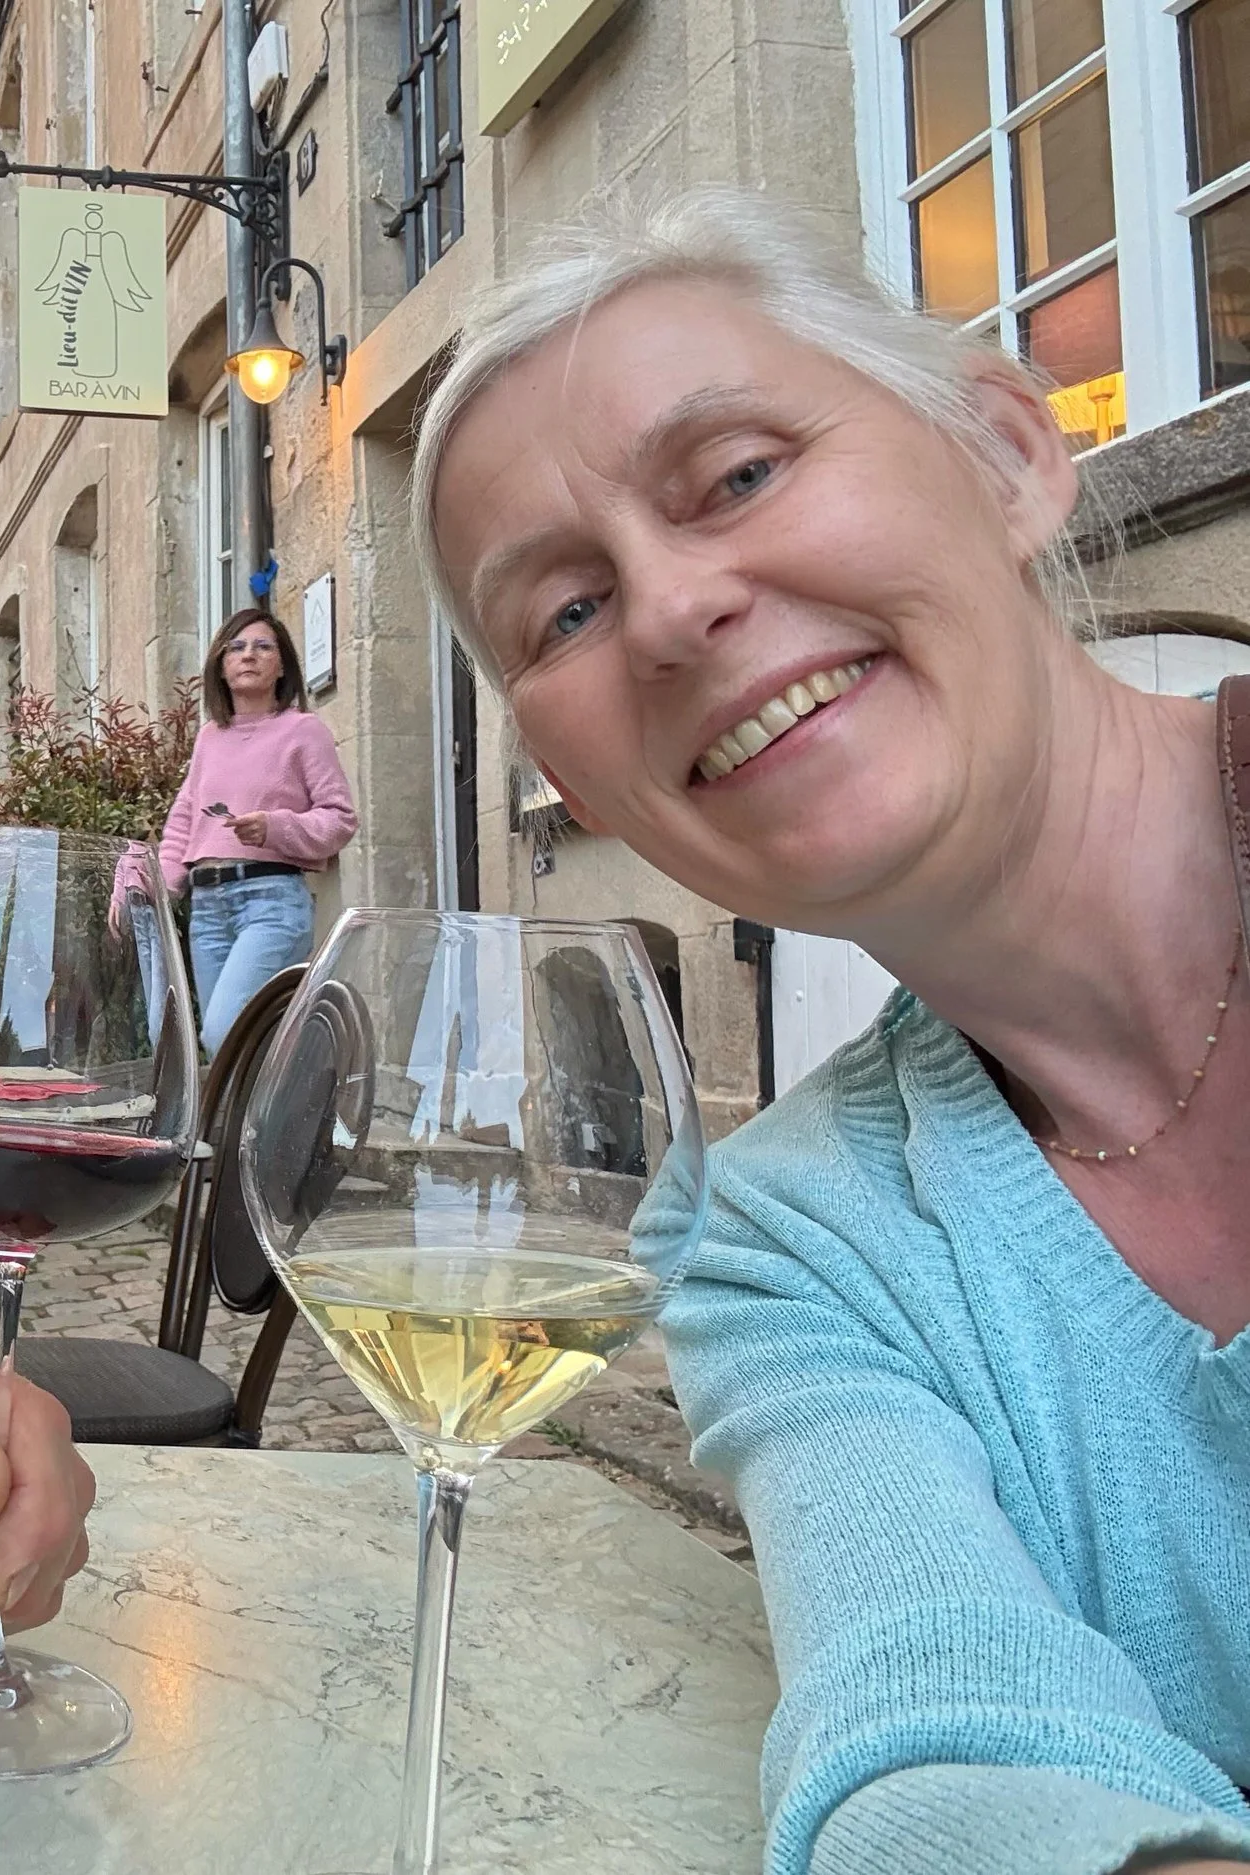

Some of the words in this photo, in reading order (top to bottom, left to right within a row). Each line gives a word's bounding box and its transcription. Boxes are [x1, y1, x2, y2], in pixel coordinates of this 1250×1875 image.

[49, 380, 88, 398] BAR
[91, 380, 107, 400] À
[107, 384, 140, 401] VIN
